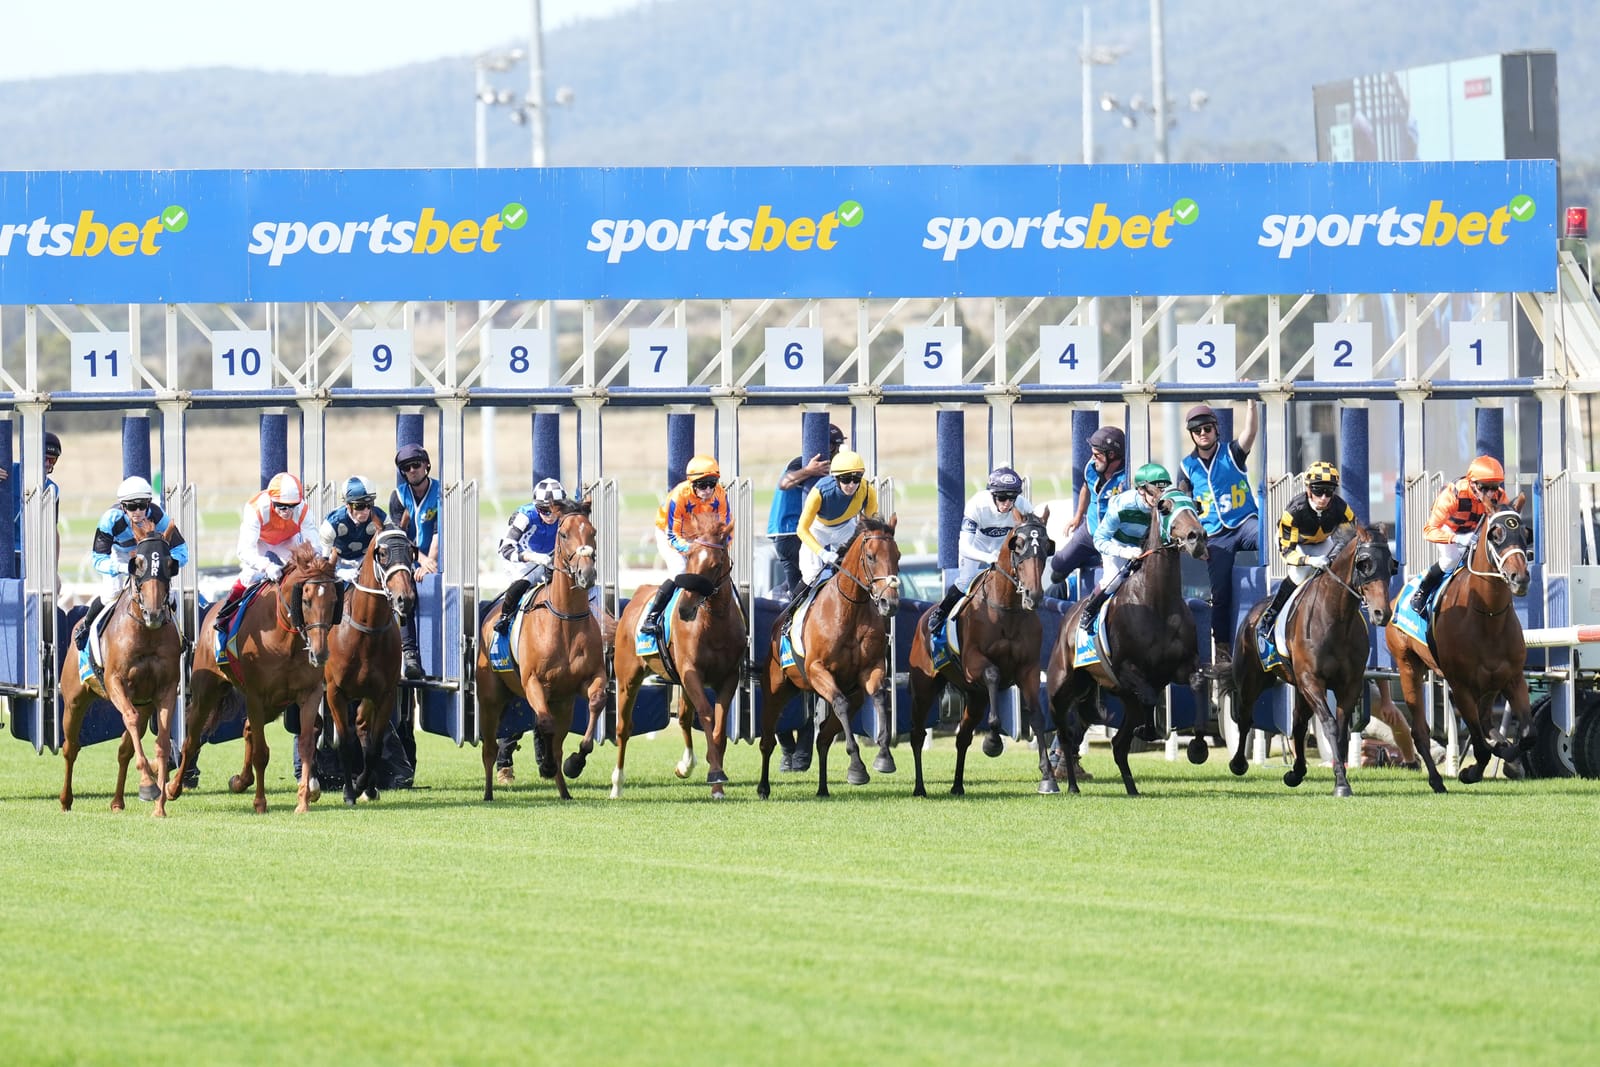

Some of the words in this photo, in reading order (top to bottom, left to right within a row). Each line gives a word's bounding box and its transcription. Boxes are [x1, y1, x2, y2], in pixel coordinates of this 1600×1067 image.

[248, 207, 505, 266] sportsbet
[586, 205, 840, 263] sportsbet
[923, 203, 1176, 261] sportsbet
[1258, 200, 1512, 259] sportsbet
[84, 350, 118, 377] 11
[222, 348, 261, 376] 10
[372, 344, 393, 372] 9
[509, 345, 530, 373] 8
[649, 345, 668, 373] 7
[785, 342, 804, 370] 6
[923, 342, 943, 370] 5
[1058, 343, 1078, 370] 4
[1196, 340, 1216, 369] 3
[1333, 339, 1353, 367] 2
[1470, 339, 1482, 366] 1
[1030, 529, 1040, 555] GAI
[151, 551, 160, 577] CMR
